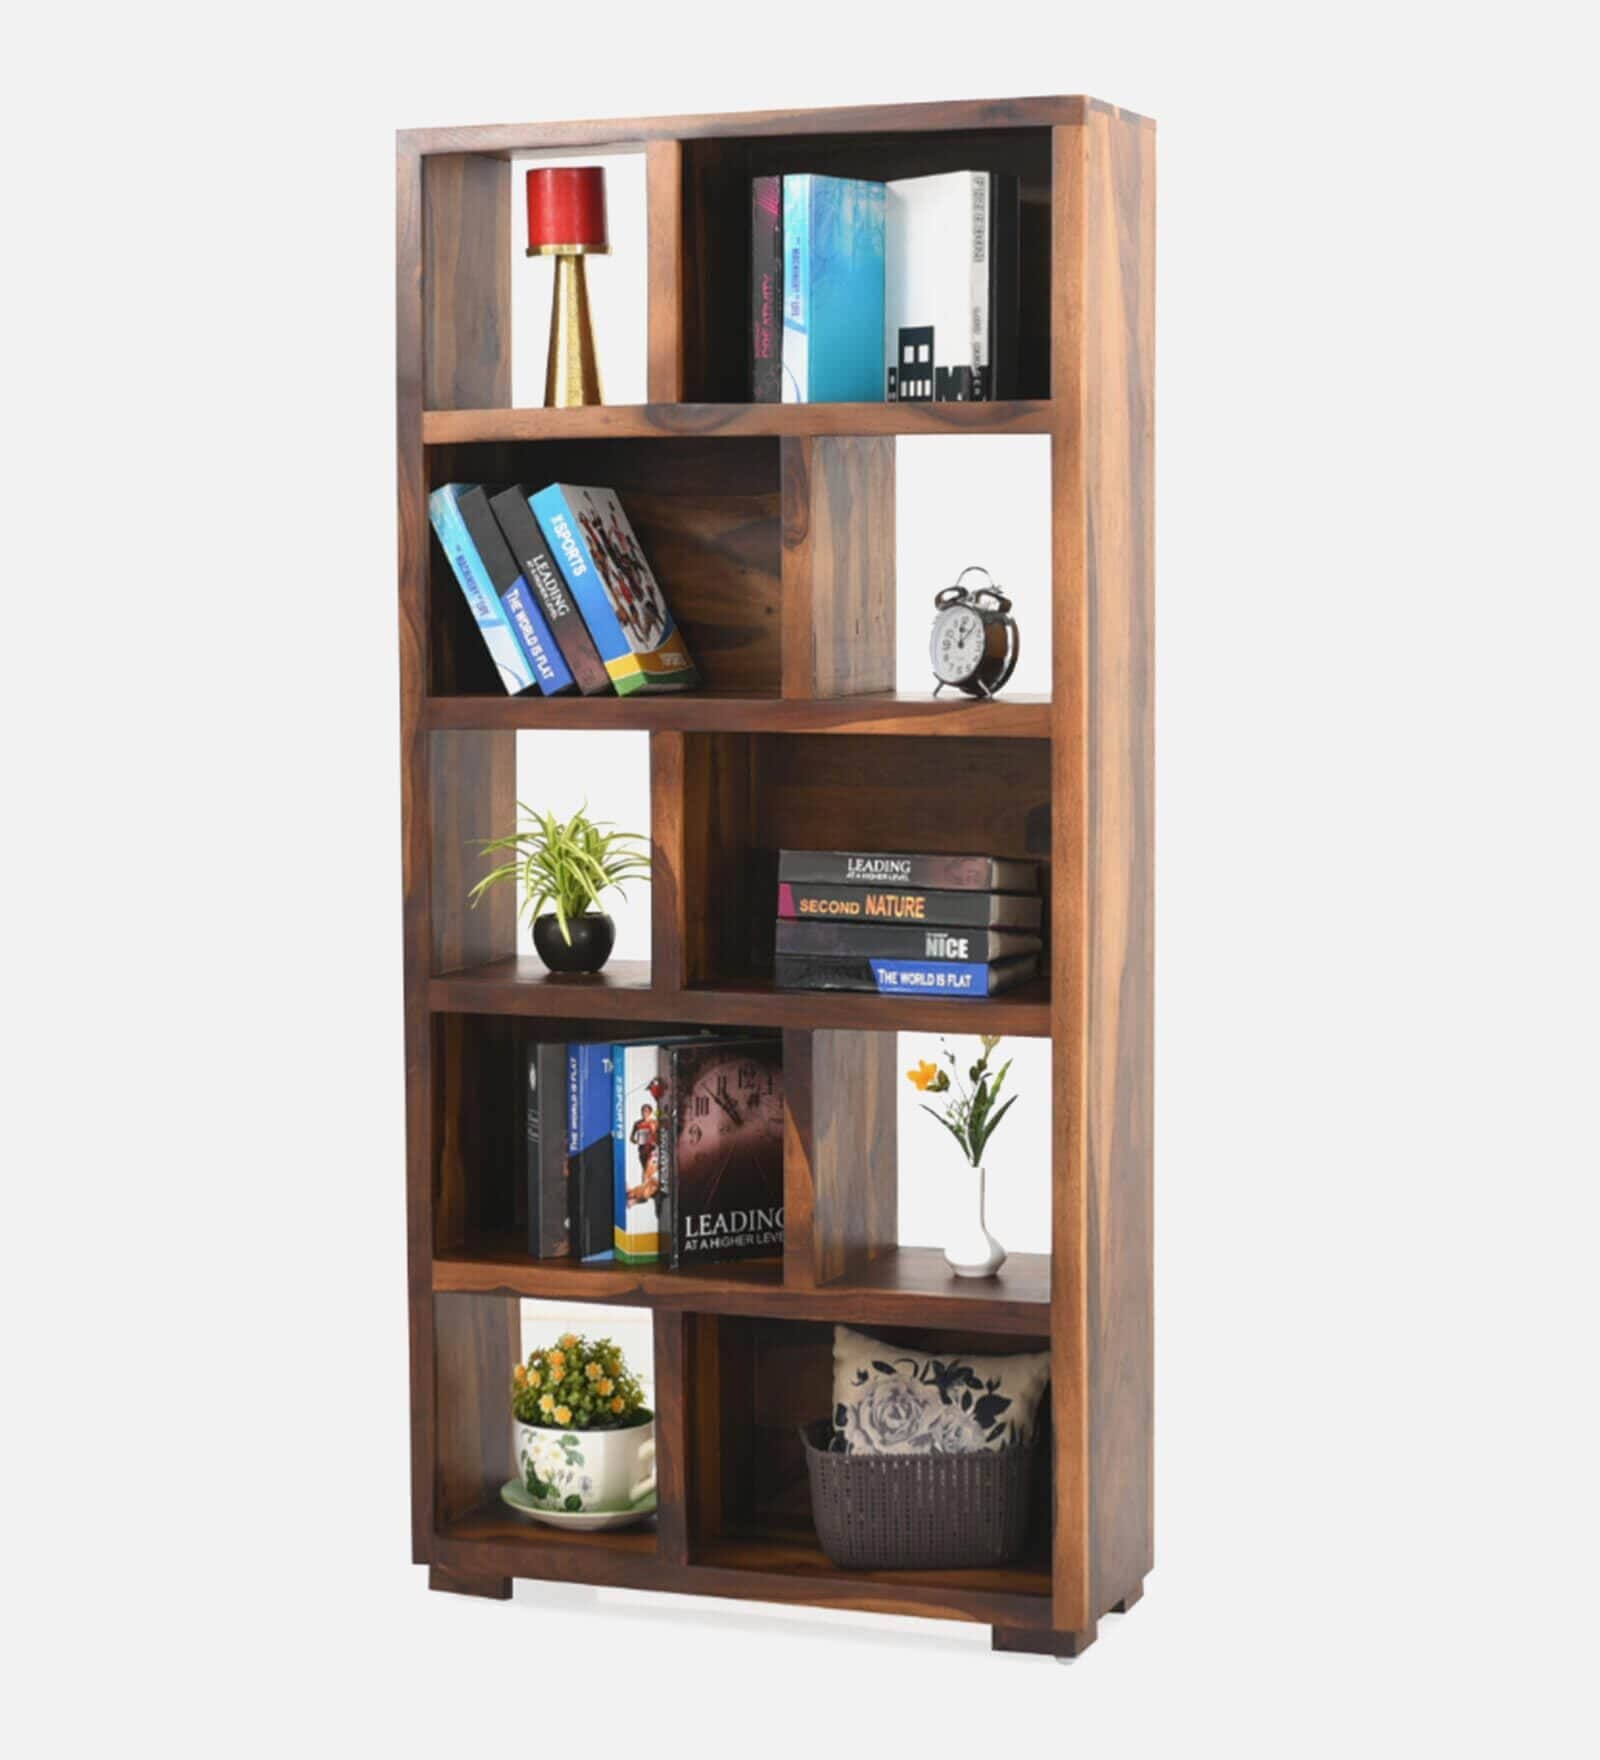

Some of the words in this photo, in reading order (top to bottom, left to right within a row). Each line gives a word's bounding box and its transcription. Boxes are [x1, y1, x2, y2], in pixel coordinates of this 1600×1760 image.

[533, 554, 570, 616] LEADING
[848, 857, 912, 873] LEADING
[799, 898, 860, 915] SECOND
[865, 894, 926, 918] NATURE
[925, 937, 969, 959] NICE
[877, 968, 899, 984] THE
[900, 970, 936, 986] WORLD
[936, 972, 945, 986] IS
[947, 973, 972, 989] FLAT
[685, 1239, 697, 1250] AT
[700, 1239, 709, 1250] A
[710, 1233, 754, 1249] HIGHER
[756, 1231, 784, 1244] LEVE
